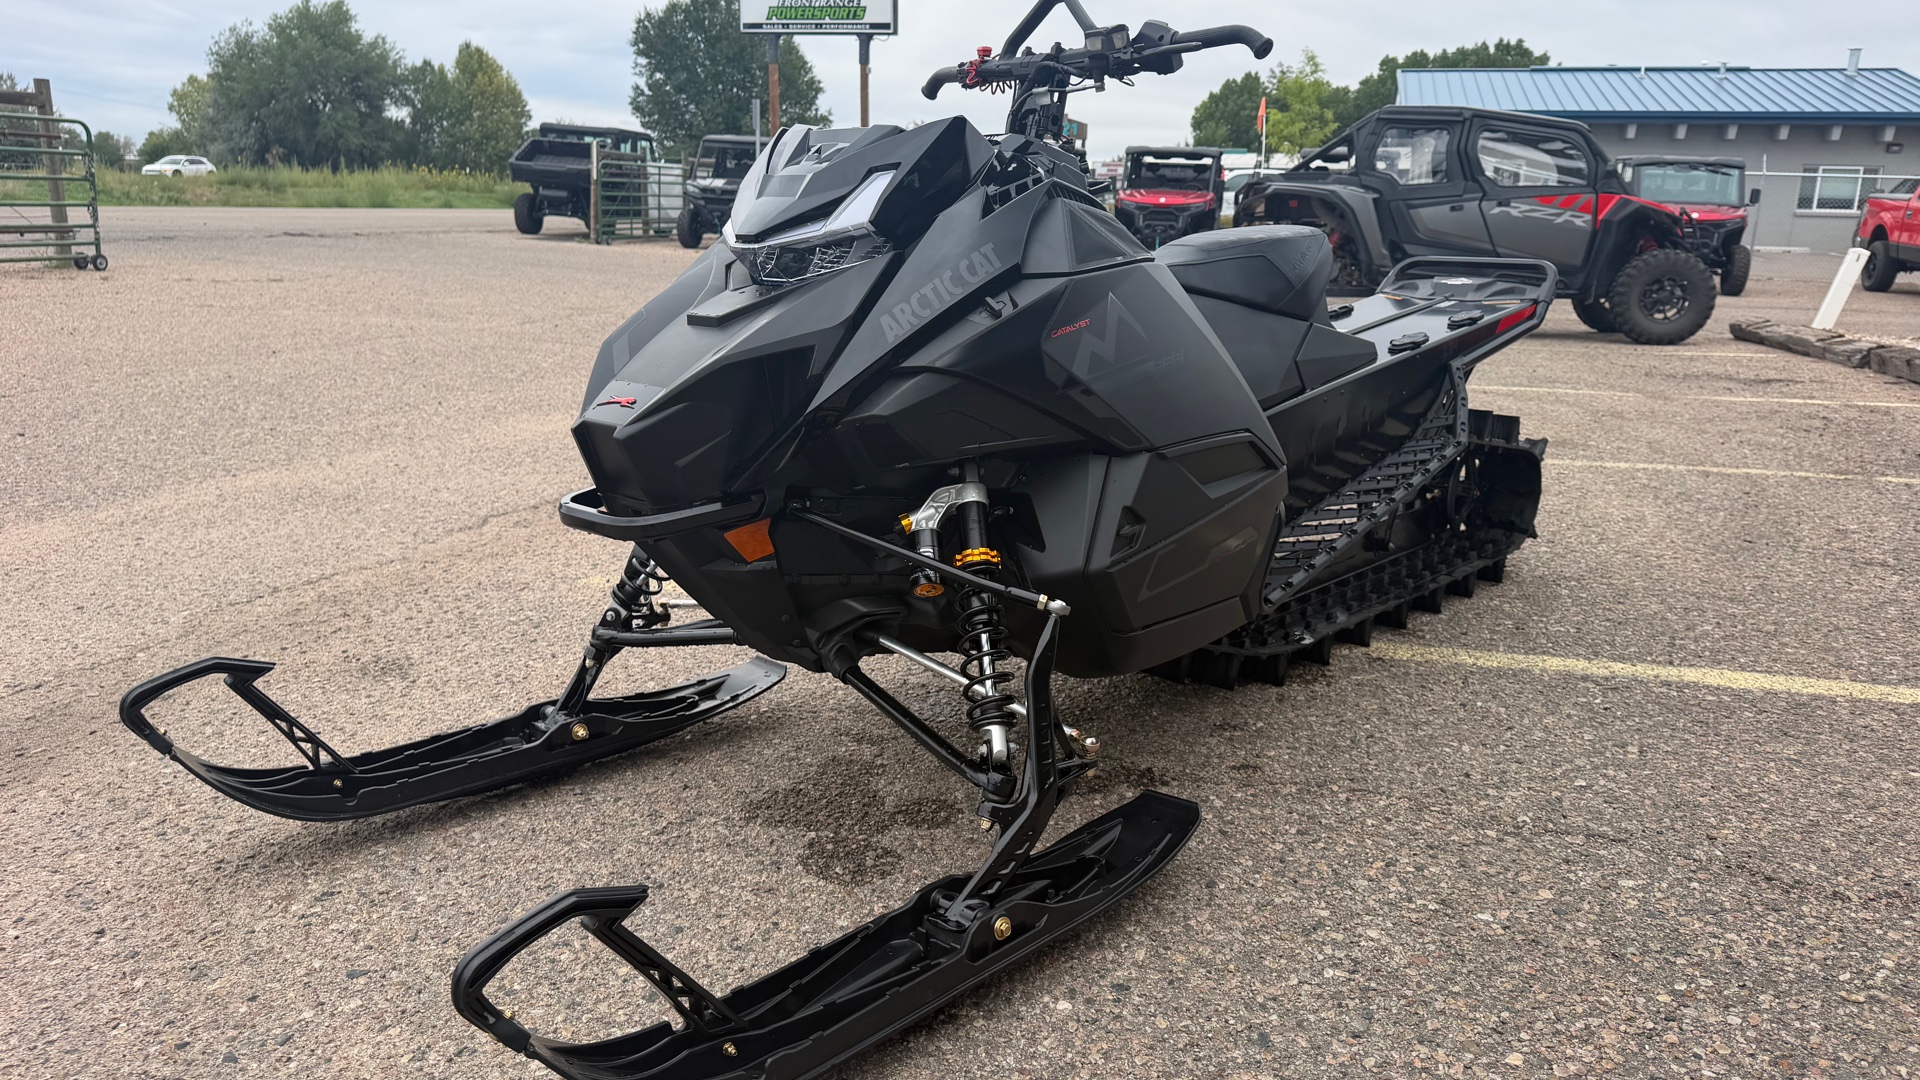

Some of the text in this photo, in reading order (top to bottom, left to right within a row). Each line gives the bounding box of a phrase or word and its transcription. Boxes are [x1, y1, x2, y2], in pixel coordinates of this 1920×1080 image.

[767, 6, 866, 20] POWERSPORTS
[1489, 202, 1593, 228] RZR
[880, 241, 1002, 344] ARCTIC CAT
[1051, 318, 1091, 338] CATALYST
